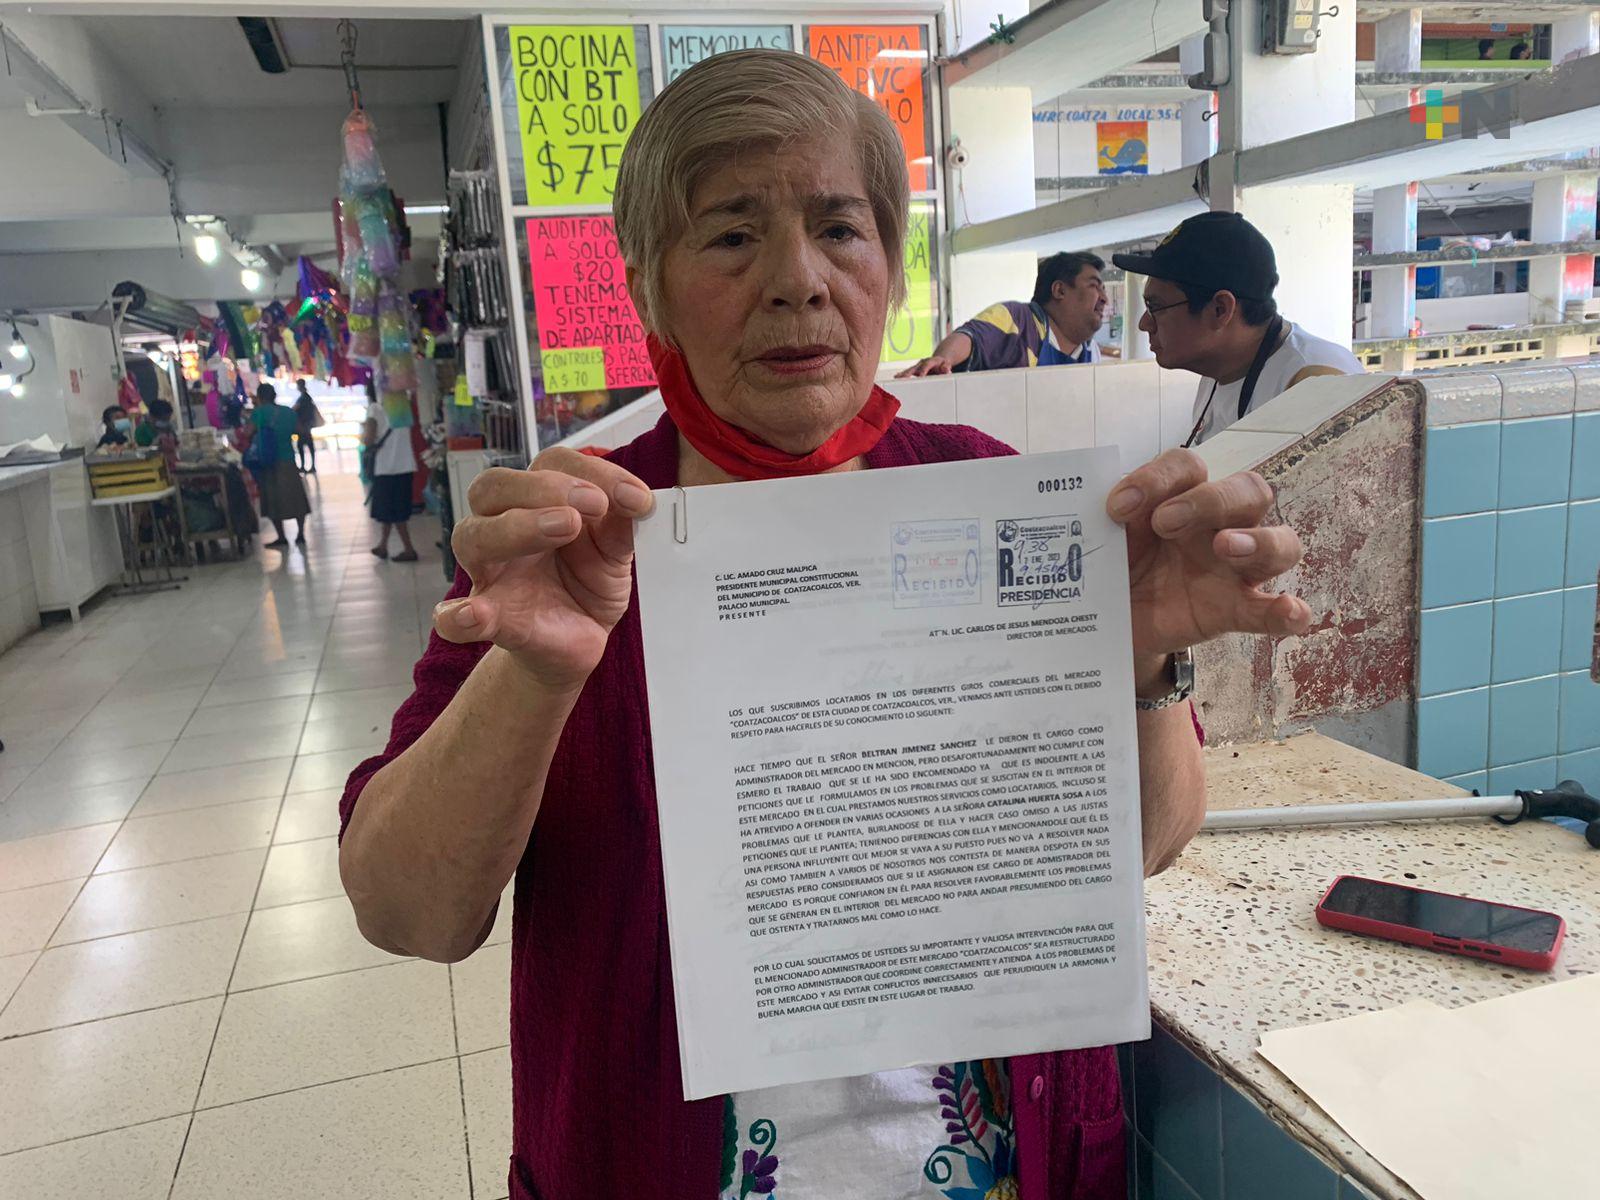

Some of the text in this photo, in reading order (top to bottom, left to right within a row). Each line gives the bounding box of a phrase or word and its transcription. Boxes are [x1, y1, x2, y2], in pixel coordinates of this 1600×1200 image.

[517, 34, 632, 69] BOCINA
[520, 69, 622, 102] CON BT
[856, 66, 905, 94] PVC
[528, 103, 627, 136] A SOLO
[537, 219, 615, 240] AUDIFON
[544, 239, 619, 261] A SOLO
[573, 260, 614, 283] $20
[543, 282, 628, 305] TENEMO
[556, 304, 633, 326] SISTEMA
[546, 323, 646, 348] DE APARTAD
[543, 349, 603, 370] CONTROLES
[619, 344, 649, 365] PAG
[1038, 476, 1083, 493] 000132
[737, 570, 765, 578] AMADO
[766, 567, 785, 576] CRUZ
[786, 564, 817, 573] MALPICA
[1000, 543, 1082, 587] RECIBIDO
[716, 570, 858, 592] PRESIDENTE MUNICIPAL CONSTITUCIONAL
[731, 590, 770, 599] MUNICIPIO
[783, 582, 844, 594] COATZACOALCOS,
[718, 602, 748, 611] PALACIO
[1000, 587, 1081, 603] PRESIDENCIA
[951, 627, 965, 635] LIC.
[966, 624, 995, 633] CARLOS
[1008, 621, 1030, 629] JESUS
[1030, 616, 1069, 626] MENDOZA
[1070, 613, 1097, 622] CHESTY
[1006, 630, 1043, 640] DIRECTOR
[728, 669, 1101, 717] LOS QUE SUSCRIBIMOS LOCATARIOS EN LOS DIFERENTES GIROS COMERCIALES DEL MERCADO
[800, 711, 811, 719] DE
[812, 709, 830, 718] ESTA
[831, 706, 860, 716] CIUDAD
[860, 704, 871, 712] DE
[957, 692, 992, 702] VENIMOS
[993, 690, 1012, 698] ANTE
[1014, 686, 1046, 696] USTEDES
[1047, 685, 1063, 693] CON
[1074, 680, 1101, 690] DEBIDO
[730, 728, 763, 739] RESPETO
[764, 726, 784, 734] PARA
[785, 721, 821, 732] HACERLES
[845, 712, 904, 725] CONOCIMIENTO
[734, 725, 1103, 774] HACE TIEMPO QUE EL SEÑOR BELTRAN JIMENEZ SANCHEZ LE DIERON EL CARGO COMO
[735, 771, 803, 786] ADMINISTRADOR
[804, 769, 819, 778] DEL
[820, 764, 861, 776] MERCADO
[862, 763, 874, 771] EN
[918, 756, 940, 764] PERO
[941, 745, 1036, 762] DESAFORTUNADAMENTE
[1038, 743, 1051, 751] NO
[1052, 740, 1085, 750] CUMPLE
[1087, 738, 1104, 746] CON
[747, 900, 788, 912] MERCADO
[792, 898, 802, 906] ES
[803, 894, 837, 905] PORQUE
[838, 887, 885, 900] CONFIARON
[886, 886, 898, 894] EN
[910, 882, 932, 891] PARA
[933, 877, 972, 888] RESOLVER
[974, 869, 1046, 883] FAVORABLEMENTE
[1048, 867, 1063, 875] LOS
[1064, 862, 1111, 874] PROBLEMAS
[754, 977, 763, 985] EL
[763, 969, 820, 983] MENCIONADO
[821, 960, 886, 975] ADMINISTRADOR
[887, 958, 898, 966] DE
[899, 956, 918, 965] ESTE
[919, 951, 958, 962] MERCADO
[1033, 941, 1048, 949] SEA
[1049, 934, 1115, 947] RESTRUCTURADO
[758, 1008, 785, 1019] BUENA
[786, 1003, 821, 1015] MARCHA
[822, 1000, 839, 1010] QUE
[841, 997, 866, 1007] EXISTE
[867, 995, 878, 1003] EN
[880, 992, 898, 1001] ESTE
[899, 989, 925, 999] LUGAR
[926, 987, 937, 995] DE
